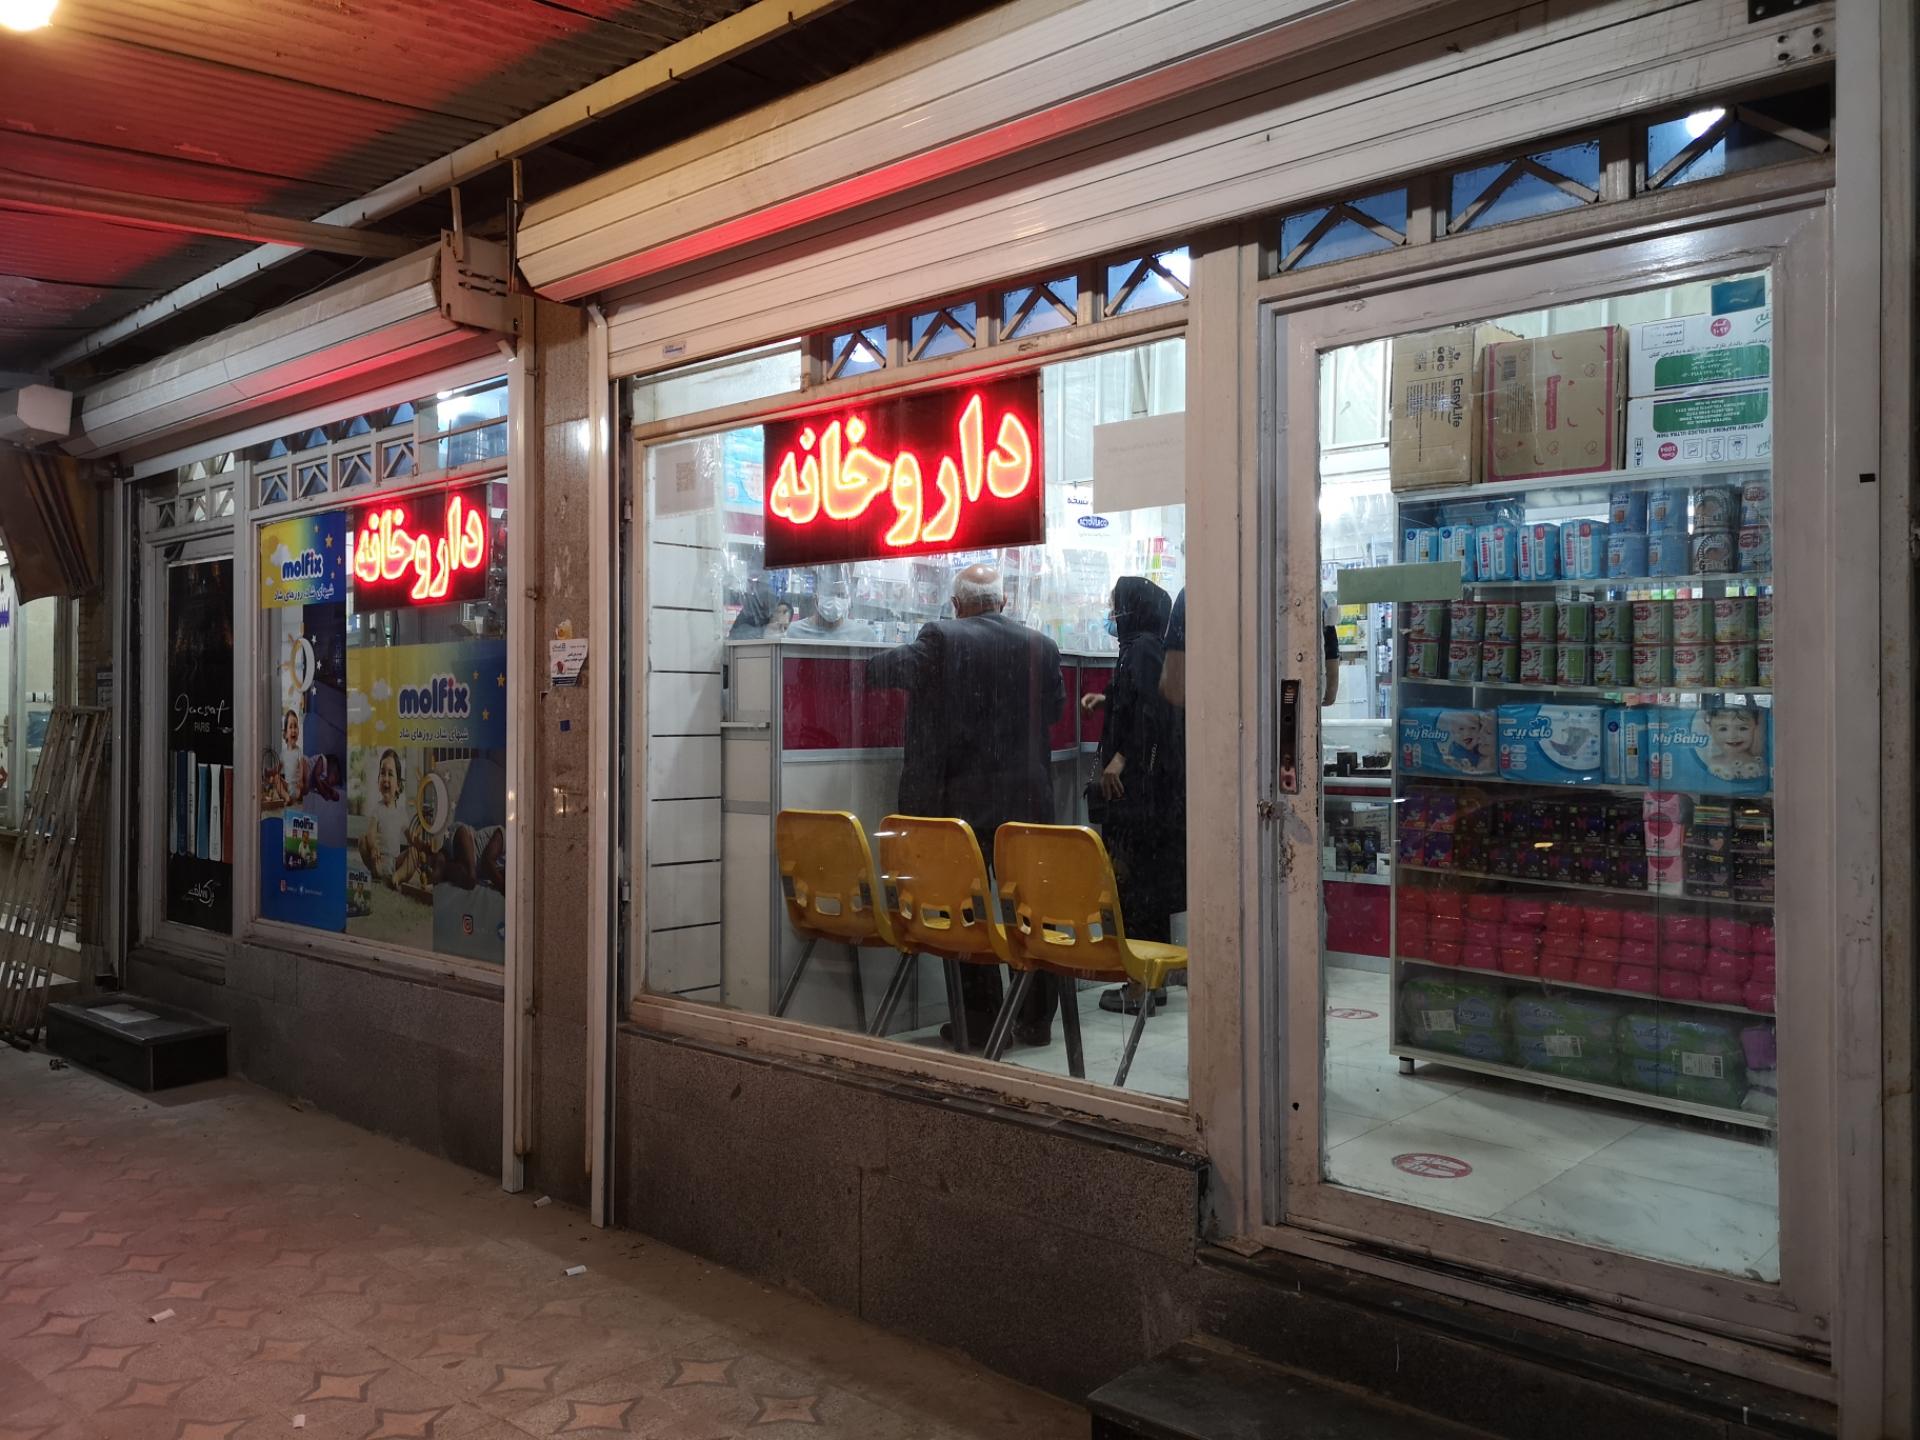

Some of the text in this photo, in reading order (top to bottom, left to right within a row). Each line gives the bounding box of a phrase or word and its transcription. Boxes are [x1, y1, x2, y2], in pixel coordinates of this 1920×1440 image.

[1450, 378, 1463, 428] EasyLife
[770, 394, 1032, 546] داروخانه
[355, 496, 484, 599] داروخانه
[282, 550, 322, 579] molfix
[399, 677, 469, 715] molfix
[399, 728, 409, 738] شاد
[1404, 727, 1449, 742] My Baby
[1652, 733, 1708, 746] My Baby
[292, 815, 315, 830] molfix
[348, 871, 368, 882] molfix
